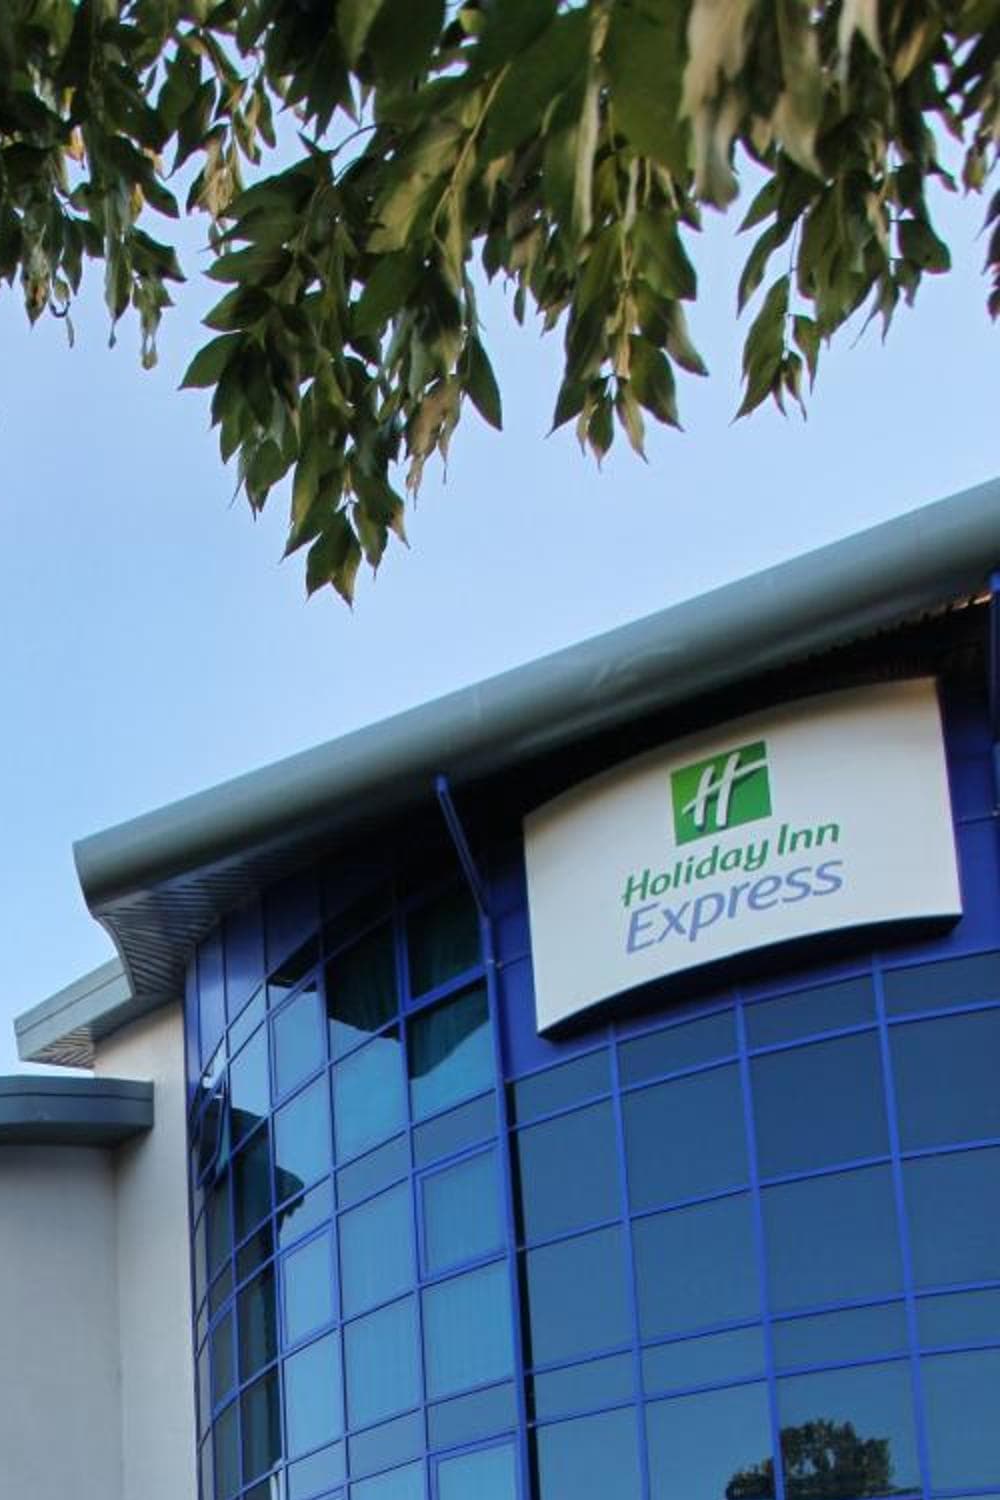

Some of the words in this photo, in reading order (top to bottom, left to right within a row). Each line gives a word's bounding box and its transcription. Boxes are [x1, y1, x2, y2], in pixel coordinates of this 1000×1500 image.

[622, 838, 769, 907] Holiday
[777, 823, 840, 857] Inn
[626, 859, 845, 954] Express
